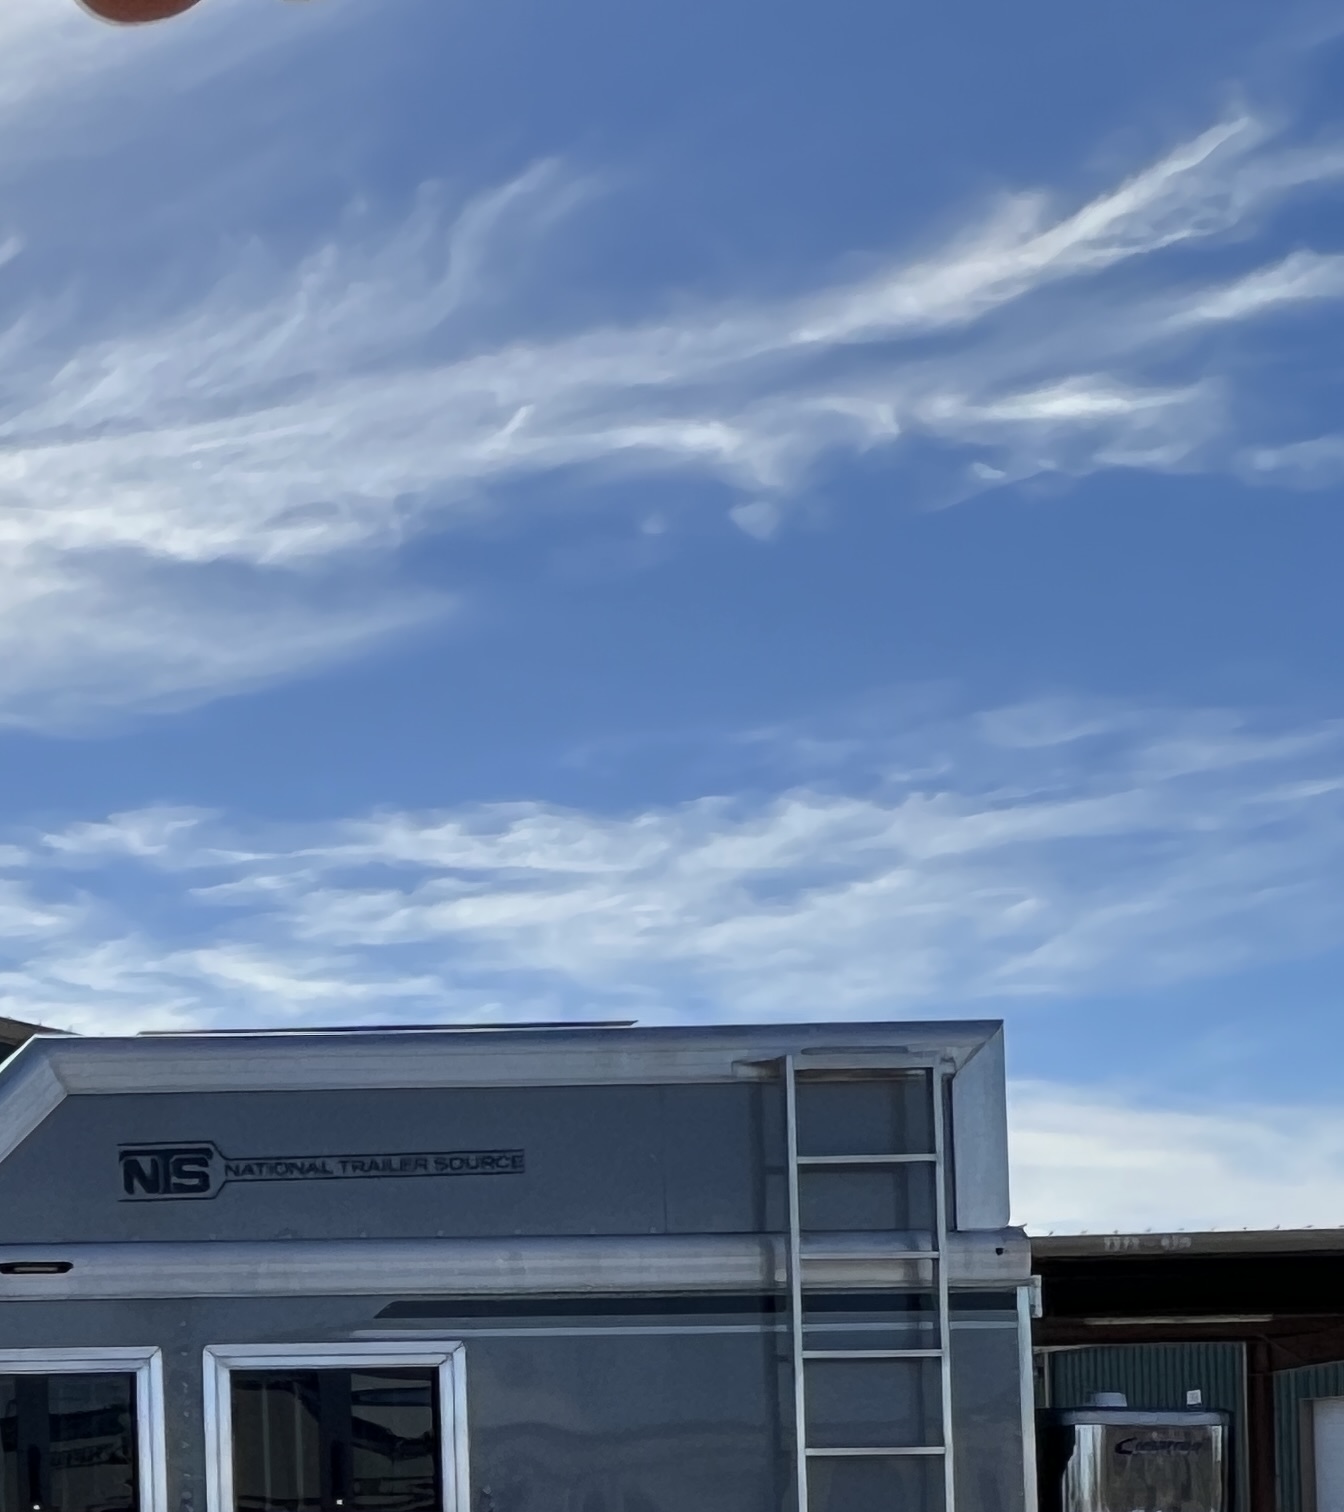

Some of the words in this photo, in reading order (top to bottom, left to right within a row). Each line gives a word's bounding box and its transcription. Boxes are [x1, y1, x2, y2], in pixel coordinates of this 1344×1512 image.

[118, 1147, 214, 1195] NTS
[224, 1158, 333, 1178] NATIONAL
[339, 1155, 429, 1175] TRAILER
[434, 1150, 525, 1172] SOURCE
